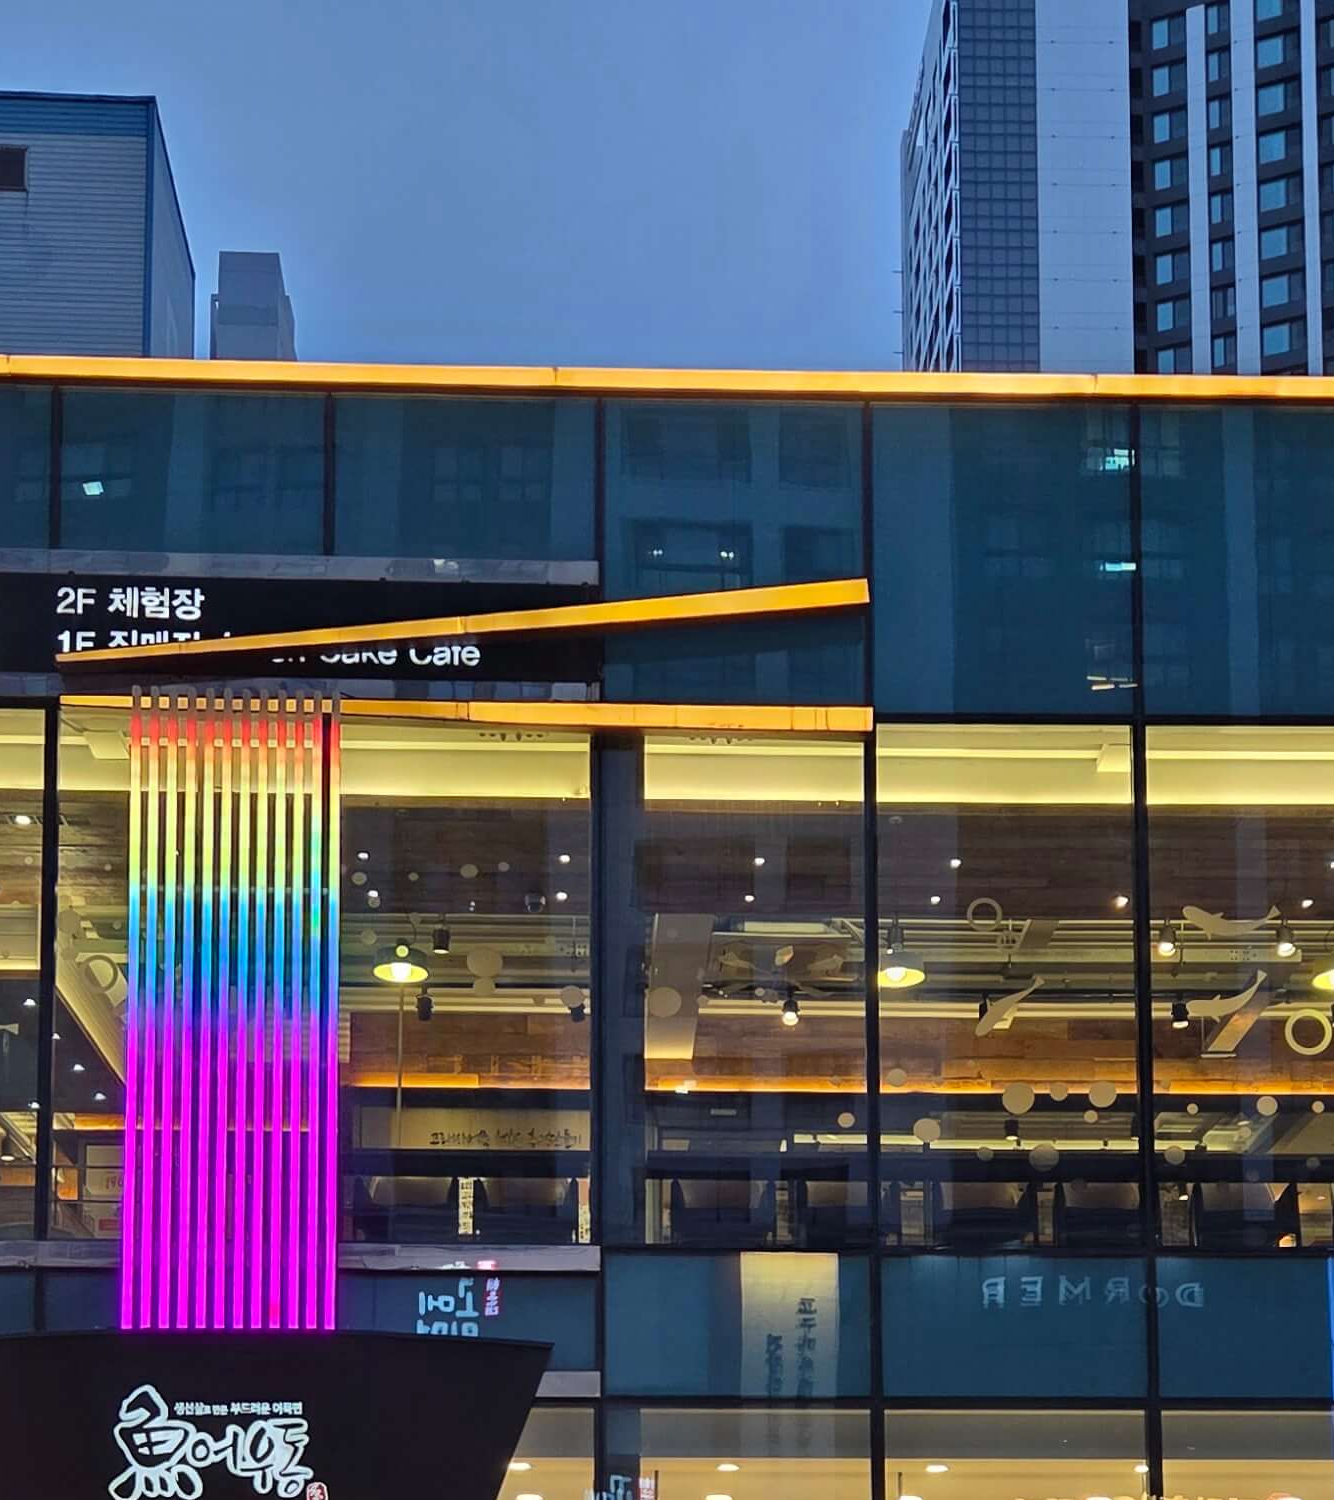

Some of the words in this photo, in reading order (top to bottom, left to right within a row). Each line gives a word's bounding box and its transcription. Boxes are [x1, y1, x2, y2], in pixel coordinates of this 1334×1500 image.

[57, 587, 96, 614] 2F
[108, 586, 205, 620] 체험장
[57, 631, 96, 652] 1F
